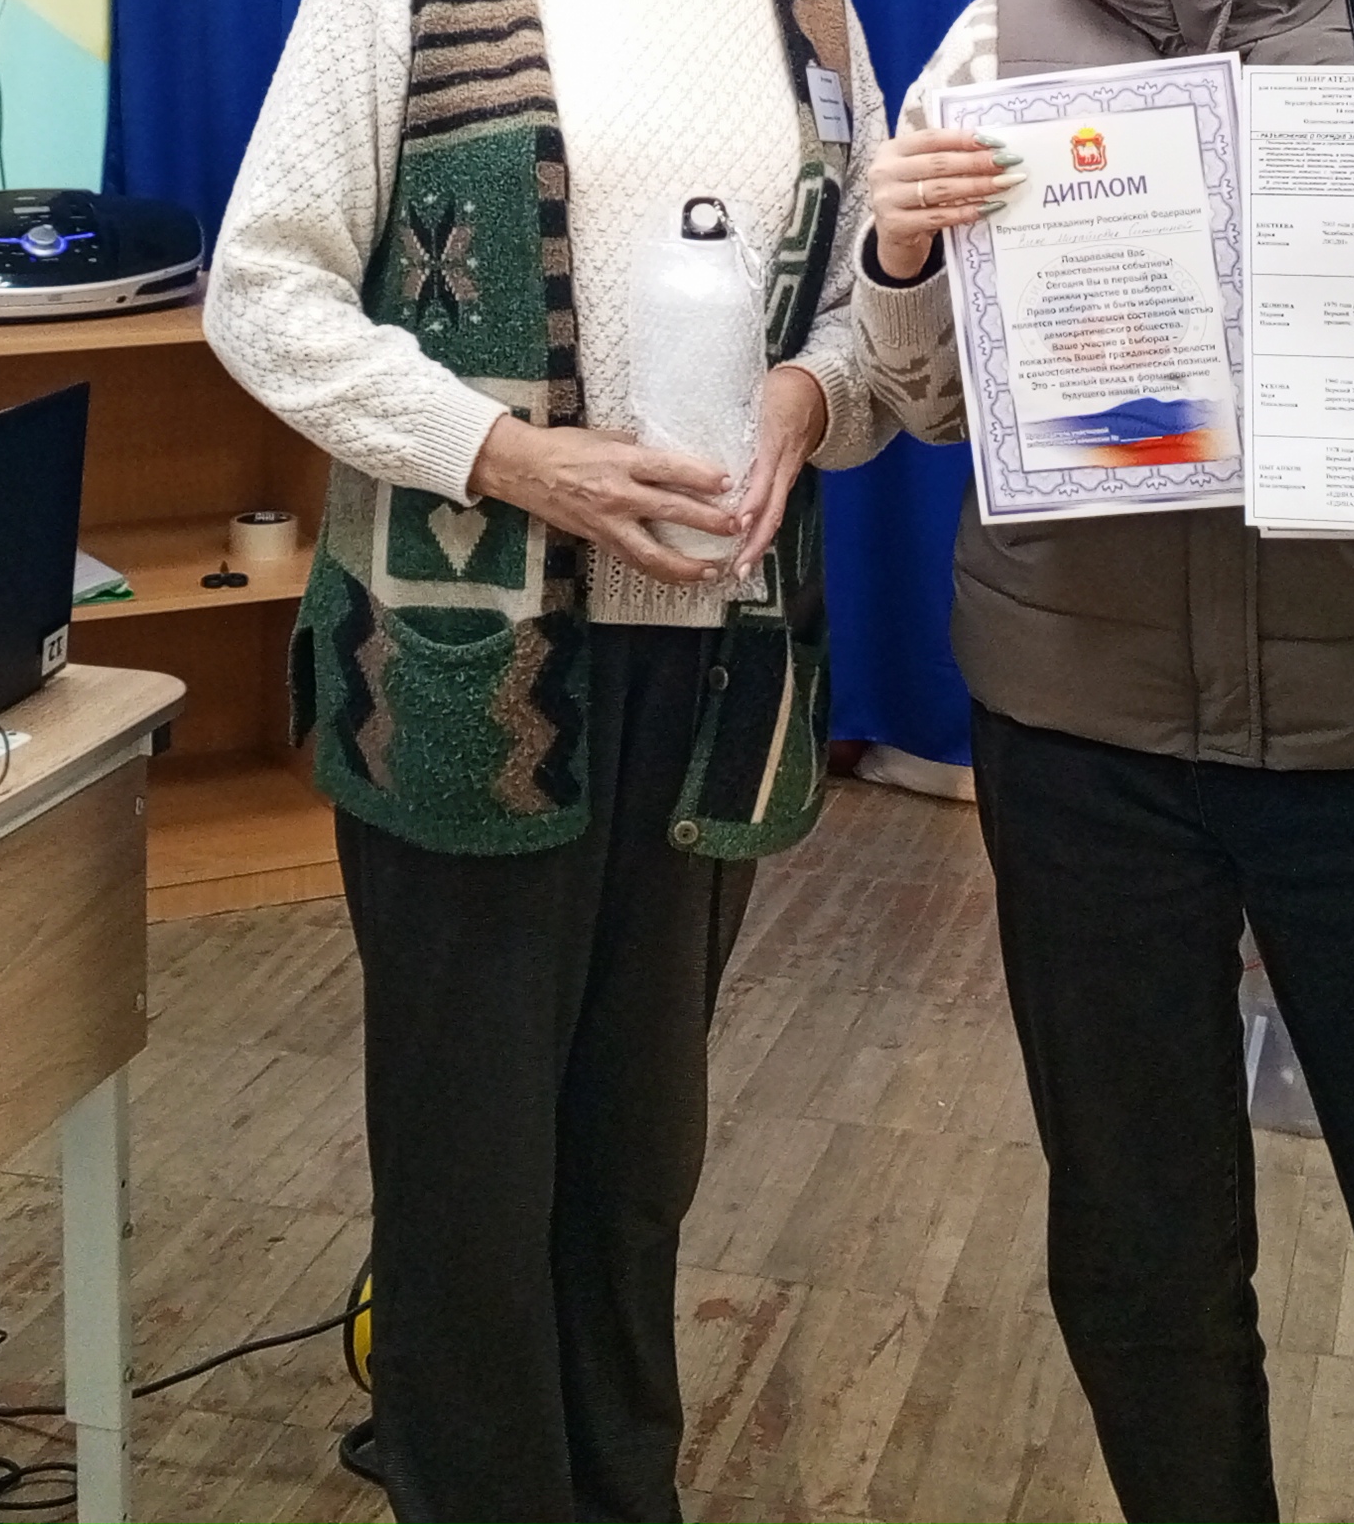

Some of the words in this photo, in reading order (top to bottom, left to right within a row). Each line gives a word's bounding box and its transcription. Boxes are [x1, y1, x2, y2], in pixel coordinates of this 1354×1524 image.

[1043, 175, 1148, 208] ДИПЛОМ
[996, 223, 1042, 236] Вручается
[1042, 218, 1095, 231] гражданину
[1096, 211, 1148, 225] Российской
[1150, 207, 1202, 221] Федерации
[1061, 252, 1125, 264] Поздравляем
[1127, 249, 1145, 258] Вас
[1045, 264, 1120, 279] торжественным
[1046, 279, 1085, 291] Сегодня
[1086, 277, 1101, 286] Вы
[1111, 272, 1148, 286] первый
[1150, 273, 1168, 284] раз
[1042, 293, 1081, 304] приняли
[1083, 289, 1120, 301] участие
[1026, 307, 1057, 319] Право
[1058, 302, 1101, 315] избирать
[1112, 299, 1136, 309] быть
[1138, 294, 1194, 309] избранным
[1127, 307, 1177, 319] составной
[1178, 305, 1214, 316] частью
[1043, 324, 1132, 341] демократического
[1133, 321, 1184, 332] общества.
[1052, 341, 1079, 351] Ваше
[1081, 338, 1118, 350] участие
[1128, 334, 1170, 345] выборах
[1019, 355, 1072, 367] показатель
[1074, 350, 1106, 362] Вашей
[1108, 346, 1171, 360] гражданской
[1172, 343, 1216, 355] зрелости
[1026, 363, 1108, 379] самостоятельной
[1110, 357, 1175, 371] политической
[1177, 355, 1221, 367] позиции.
[1031, 381, 1048, 391] Это
[1062, 389, 1106, 401] будущего
[1108, 386, 1140, 396] нашей
